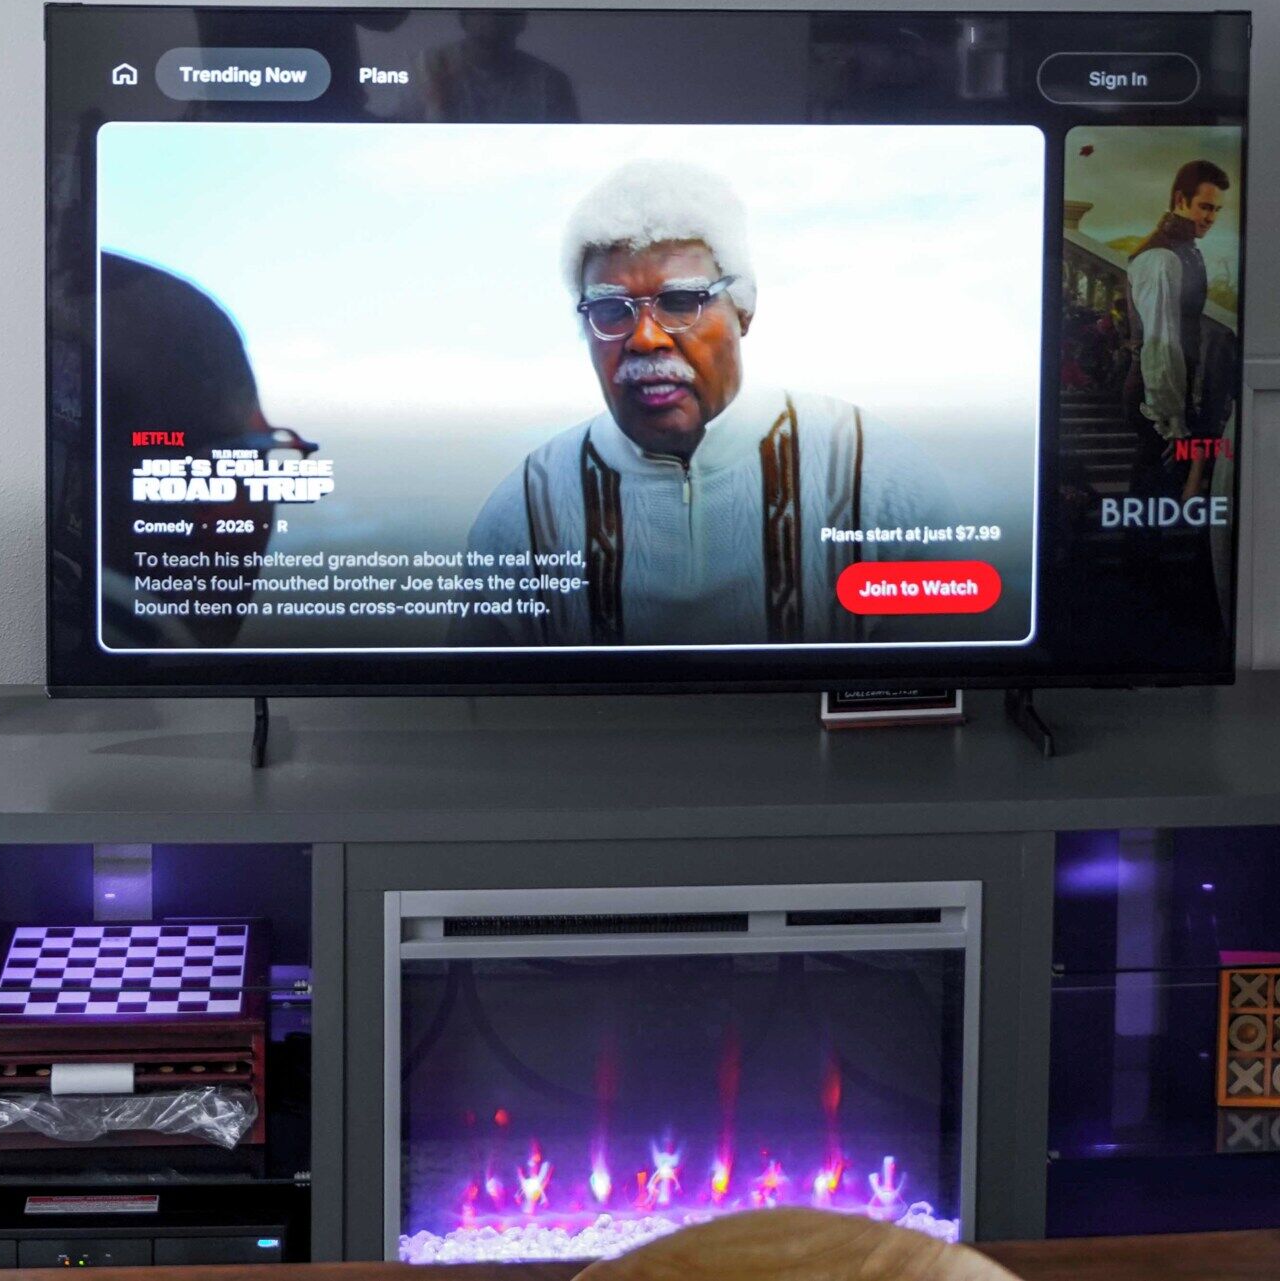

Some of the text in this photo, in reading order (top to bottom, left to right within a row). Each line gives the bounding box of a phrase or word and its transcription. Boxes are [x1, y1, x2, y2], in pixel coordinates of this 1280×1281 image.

[179, 66, 307, 87] Trending Now
[359, 67, 409, 84] Plans
[1089, 71, 1148, 90] Sign In
[132, 431, 185, 447] NETFLIX
[132, 456, 334, 477] JOE'S COLLEGE
[132, 477, 335, 503] ROAD TRIP
[1101, 497, 1228, 528] BRIDGE
[133, 519, 289, 536] Comedy 2026 R
[821, 525, 1002, 545] Plans start at just $7.99
[134, 551, 587, 571] To teach his sheltered grandson about the real world,
[135, 574, 590, 594] Madea's foul-mouthed brother Joe takes the college-
[858, 579, 978, 597] Join to Watch
[135, 598, 551, 619] bound teen on a raucous cross-country road trip.
